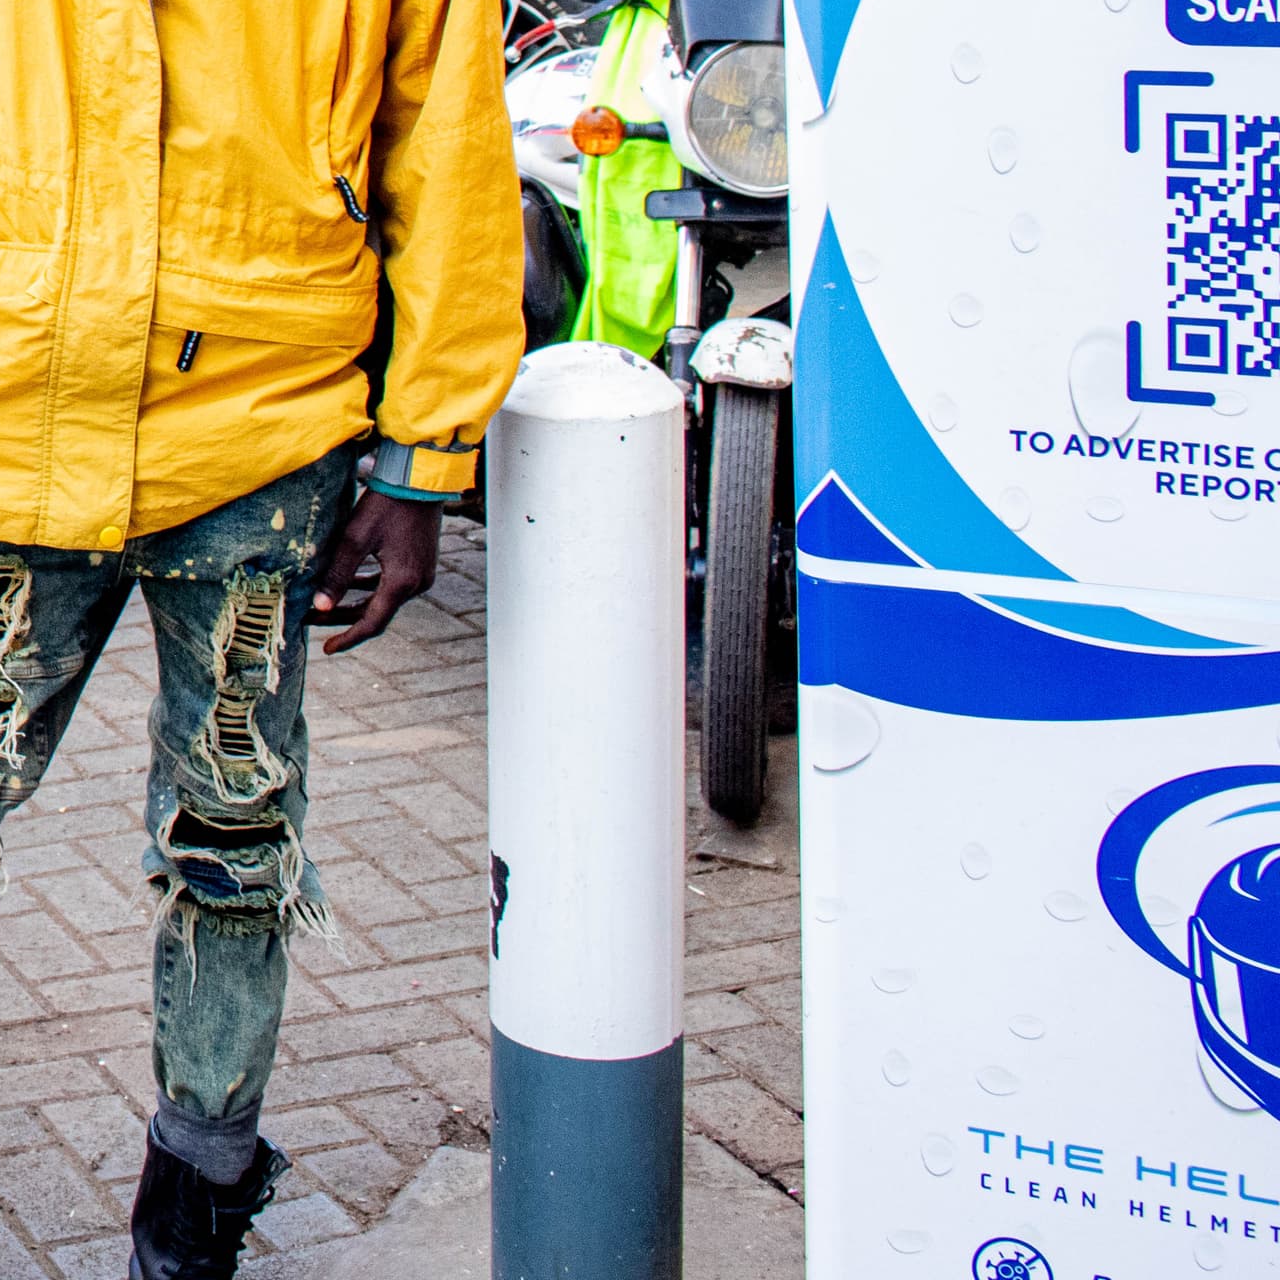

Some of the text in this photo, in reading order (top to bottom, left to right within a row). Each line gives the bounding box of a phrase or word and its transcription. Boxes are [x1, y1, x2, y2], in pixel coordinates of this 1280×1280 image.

[1009, 430, 1055, 455] TO
[1063, 434, 1255, 470] ADVERTISE
[1156, 471, 1280, 503] REPOR
[967, 1126, 1104, 1174] THE
[980, 1172, 1097, 1209] CLEAN
